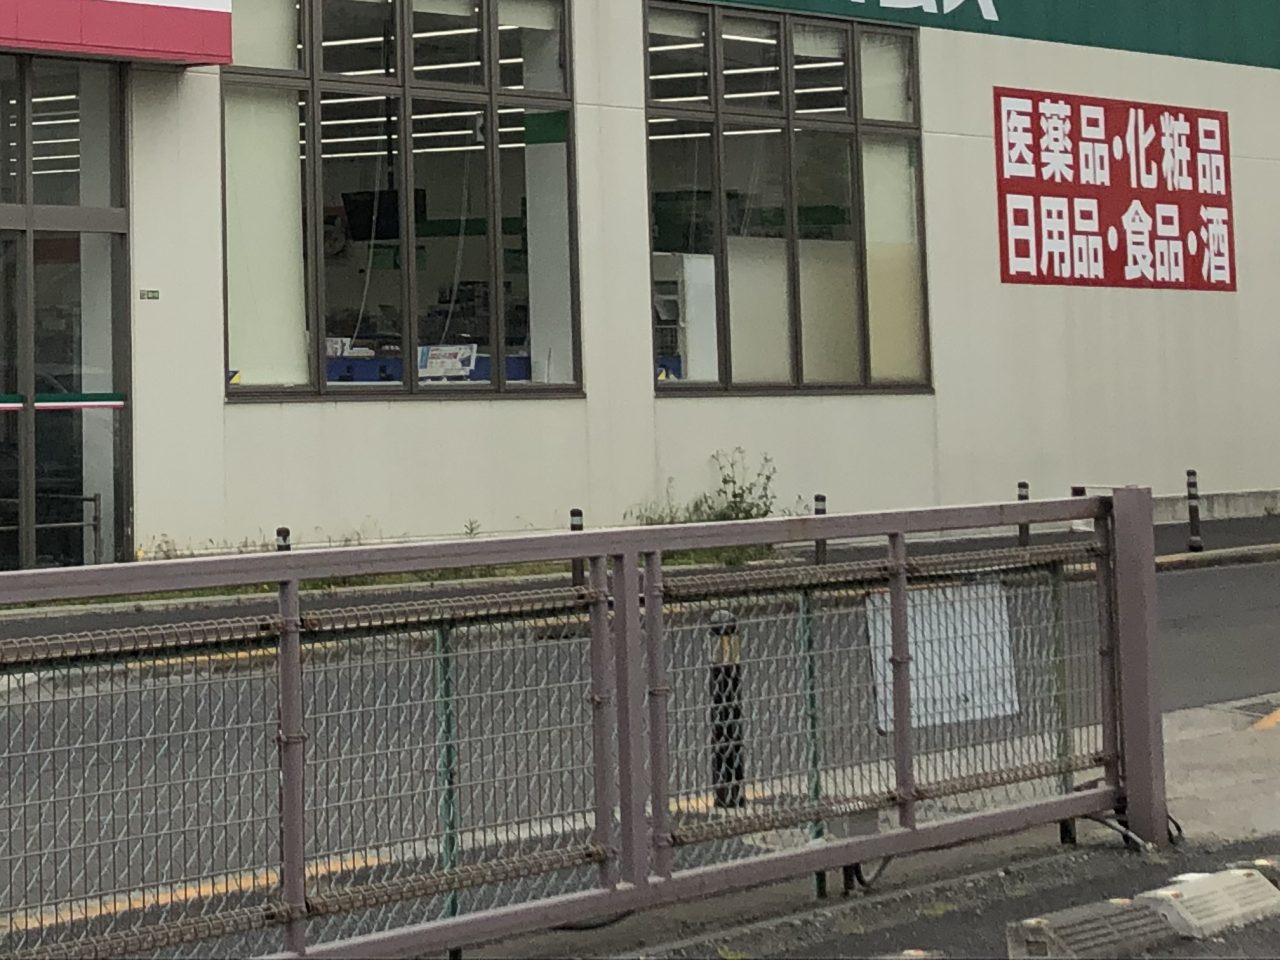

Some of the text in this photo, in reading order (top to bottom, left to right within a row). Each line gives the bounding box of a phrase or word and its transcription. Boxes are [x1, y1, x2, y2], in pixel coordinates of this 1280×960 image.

[1000, 96, 1226, 195] 医薬品・化粧品
[1005, 193, 1231, 284] 日用品・食品・酒
